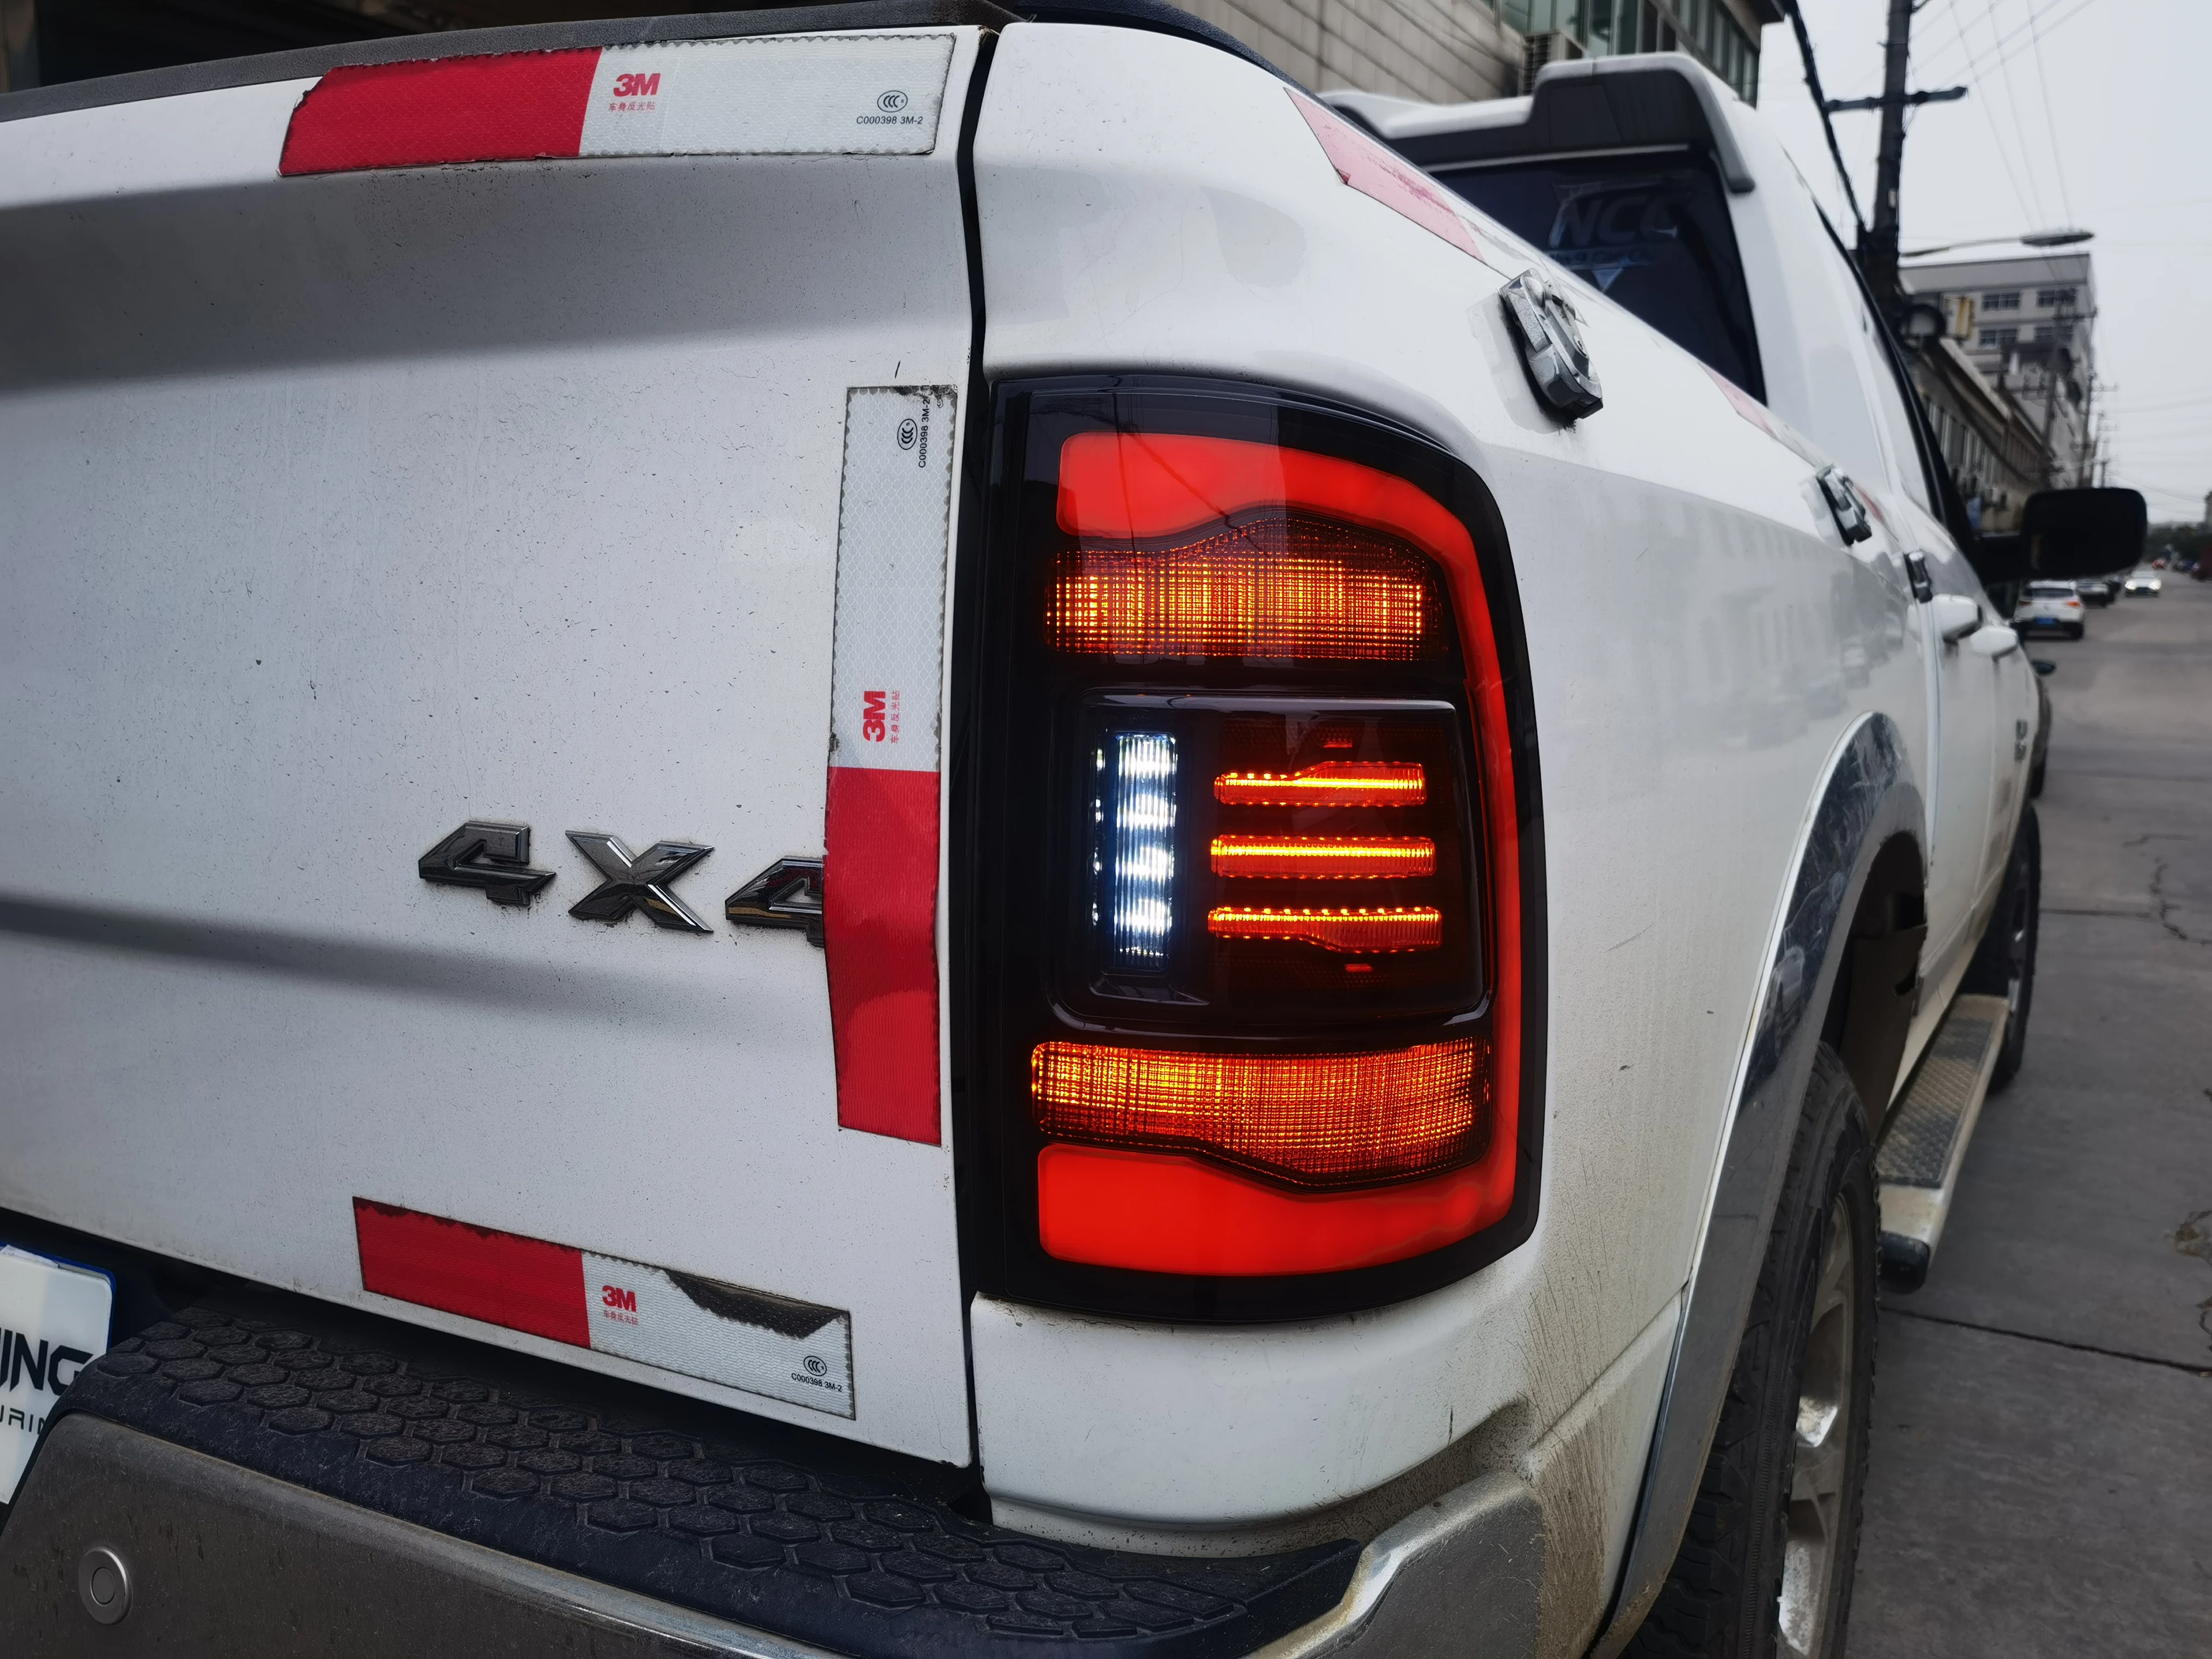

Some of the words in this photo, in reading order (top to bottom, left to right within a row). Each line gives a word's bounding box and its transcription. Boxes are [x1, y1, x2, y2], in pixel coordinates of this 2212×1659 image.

[613, 72, 661, 97] 3M
[856, 116, 897, 124] C000398
[900, 116, 923, 124] 3M-2
[921, 399, 930, 422] 3M-2
[918, 426, 928, 468] C000398
[863, 691, 886, 742] 3M
[891, 690, 900, 744] 车身反光贴
[419, 820, 825, 947] 4X4
[602, 1285, 637, 1313] 3M
[791, 1373, 822, 1387] C000398
[824, 1381, 842, 1392] 3M-2
